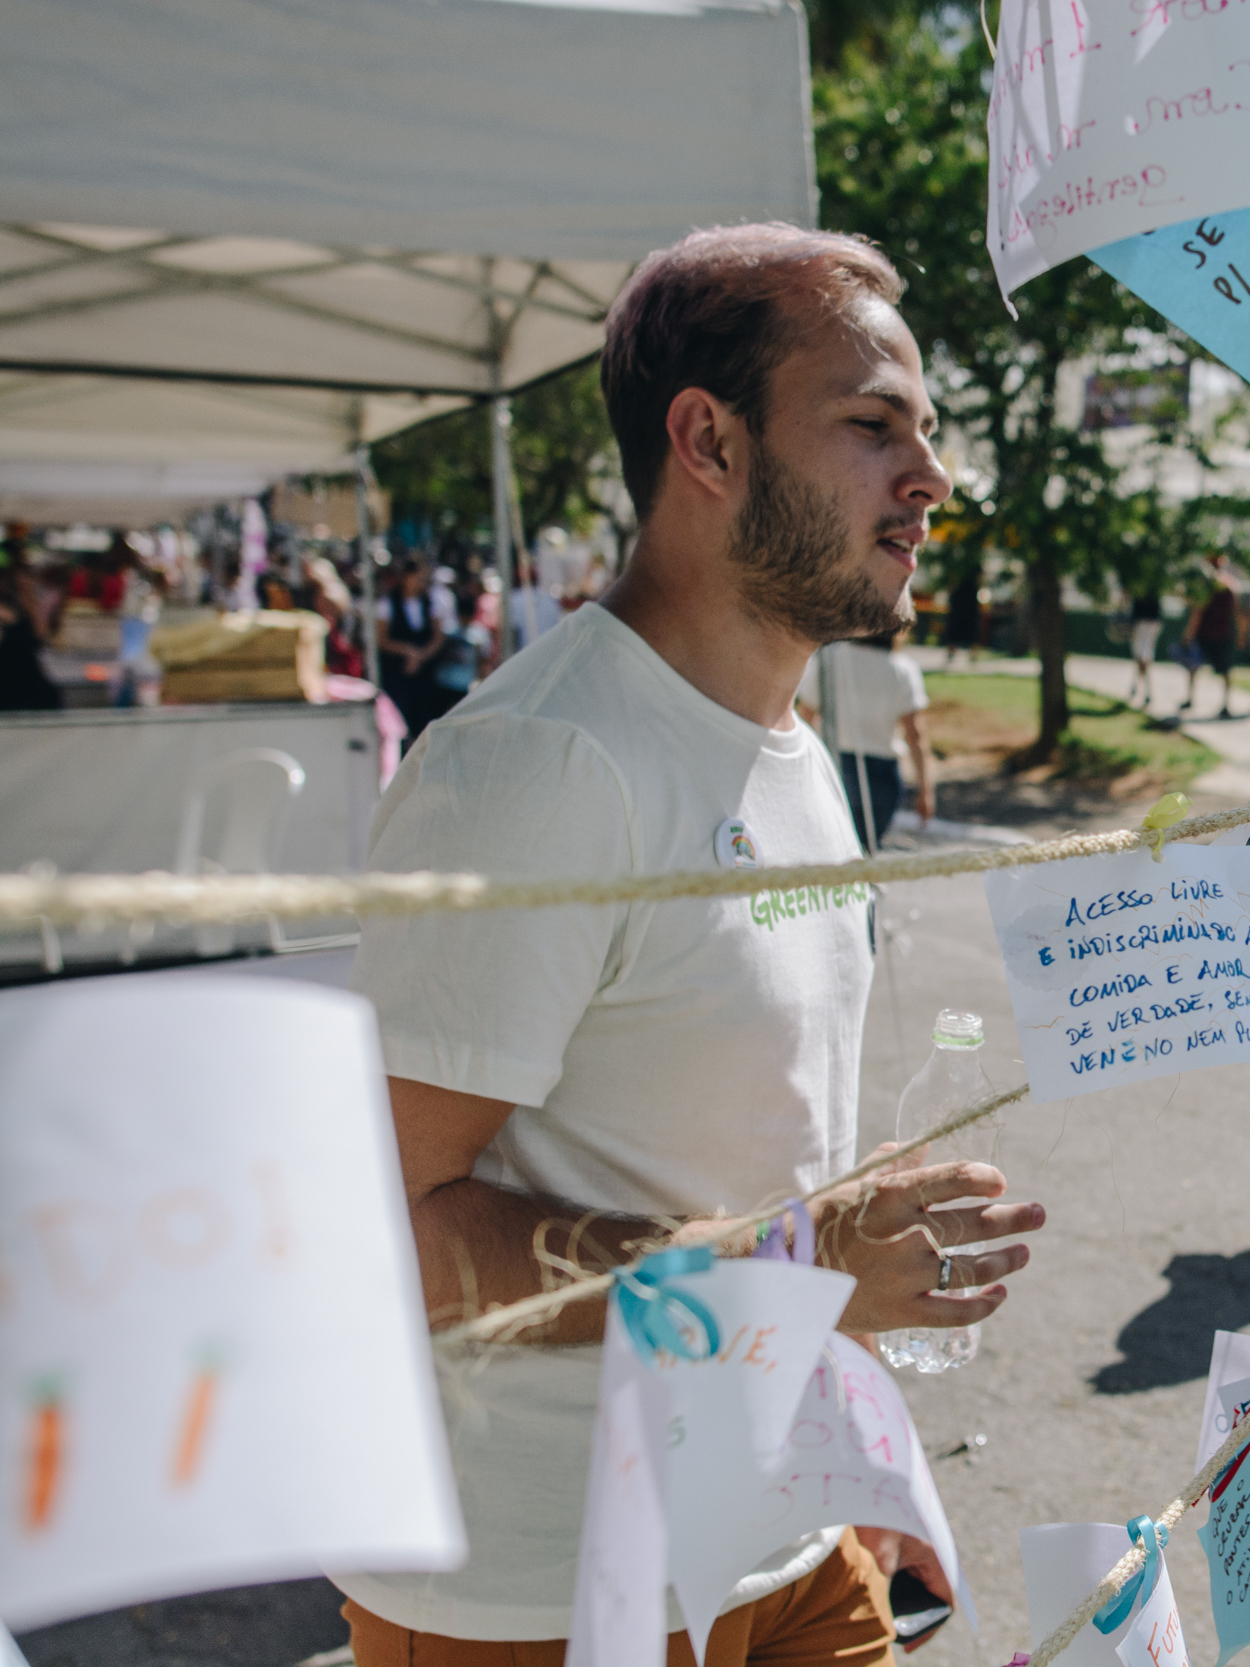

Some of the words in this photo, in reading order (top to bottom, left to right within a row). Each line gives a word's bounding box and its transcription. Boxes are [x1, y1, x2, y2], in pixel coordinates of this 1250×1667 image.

[1183, 217, 1225, 269] SE
[1065, 890, 1153, 927] ACESSO
[1171, 880, 1224, 900] LIVRE
[1038, 947, 1056, 967] E
[1069, 917, 1236, 960] INDISCRIMINADO
[1068, 973, 1153, 1008] COMIDA
[1165, 965, 1183, 984] E
[1197, 958, 1250, 981] AMOR
[1066, 1021, 1094, 1046] DE
[1187, 1028, 1227, 1052] NEM
